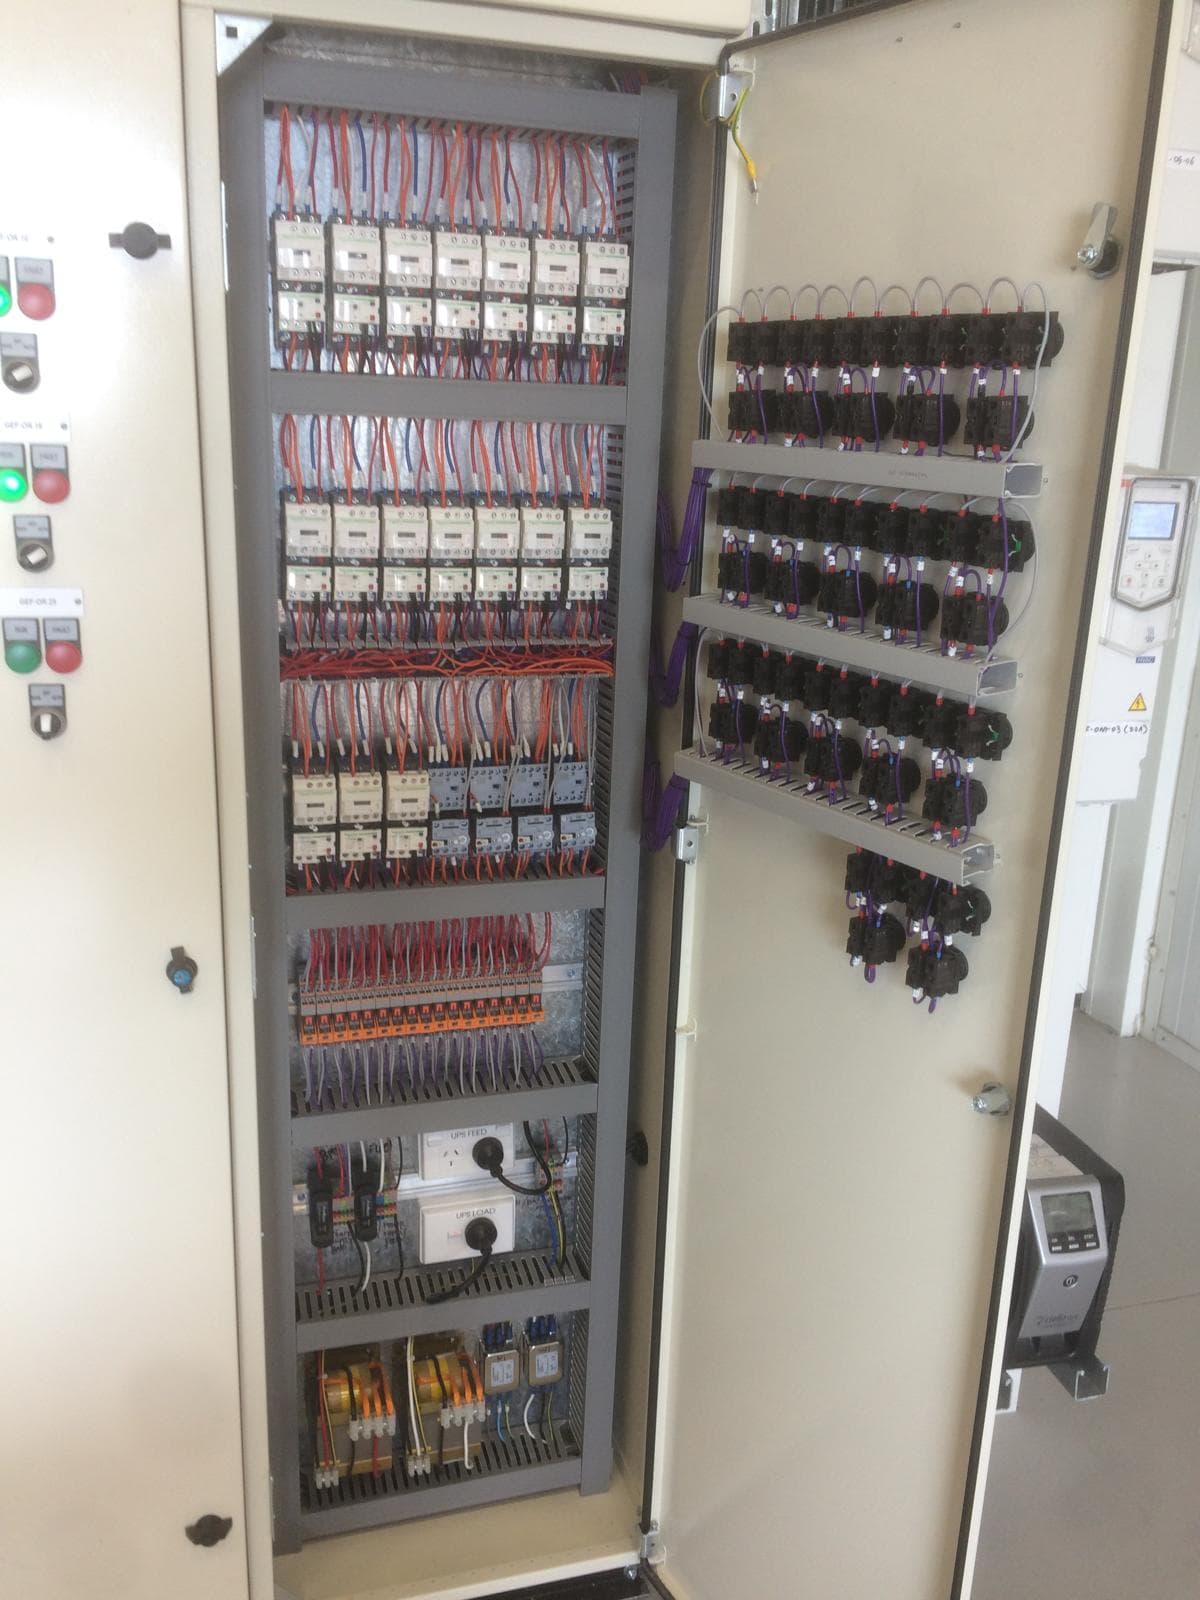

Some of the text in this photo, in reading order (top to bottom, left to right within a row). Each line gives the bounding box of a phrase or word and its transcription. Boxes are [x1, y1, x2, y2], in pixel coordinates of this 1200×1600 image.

[450, 1127, 488, 1140] UPS FEED
[456, 1207, 496, 1220] UPS LOAD
